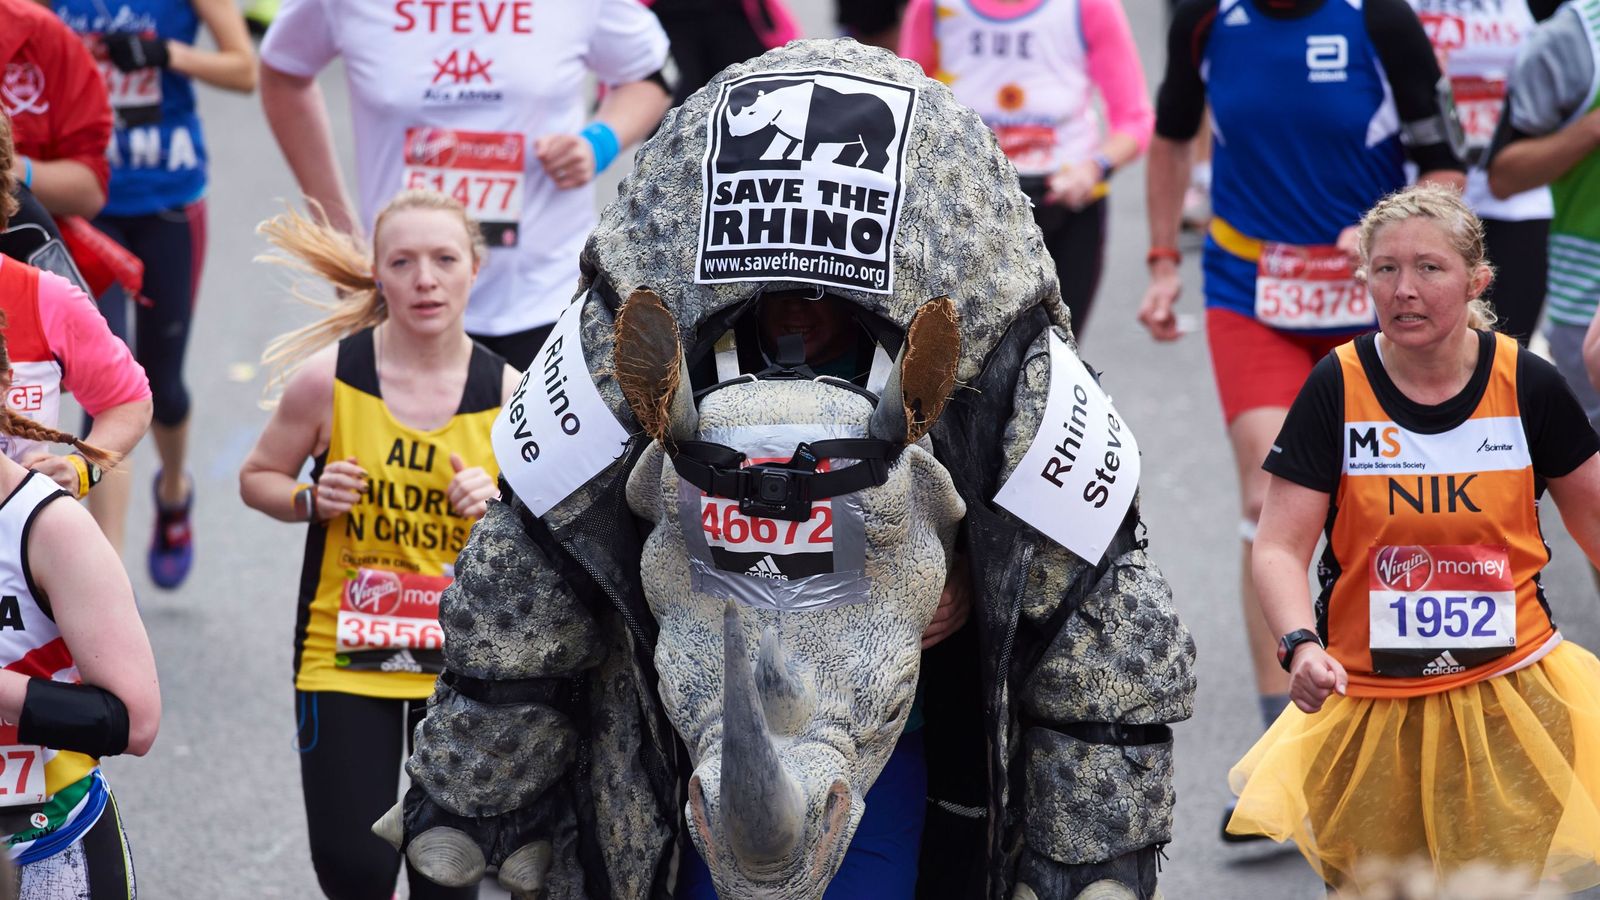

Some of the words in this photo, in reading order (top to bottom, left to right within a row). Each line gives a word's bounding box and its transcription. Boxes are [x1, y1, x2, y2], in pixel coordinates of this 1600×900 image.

[394, 0, 533, 33] STEVE
[971, 30, 1034, 59] SUE
[713, 178, 804, 206] SAVE
[818, 180, 890, 216] THE
[710, 207, 884, 255] RHINO
[704, 252, 885, 287] www.savetherhino.org
[1262, 284, 1369, 318] 53478
[544, 334, 581, 436] Rhino
[509, 371, 540, 463] Steve
[386, 437, 437, 473] ALI
[1040, 384, 1088, 489] Rhino
[1349, 427, 1401, 459] MS
[1083, 413, 1122, 509] Steve
[1349, 462, 1374, 470] Multiple
[1402, 462, 1426, 470] Society
[1388, 474, 1482, 515] NIK
[374, 515, 466, 553] CRISIS
[1379, 546, 1429, 588] Virgin
[1437, 559, 1505, 579] money
[350, 570, 399, 613] Virgin
[0, 595, 25, 631] A
[1389, 596, 1497, 637] 1952
[1508, 637, 1515, 645] 9
